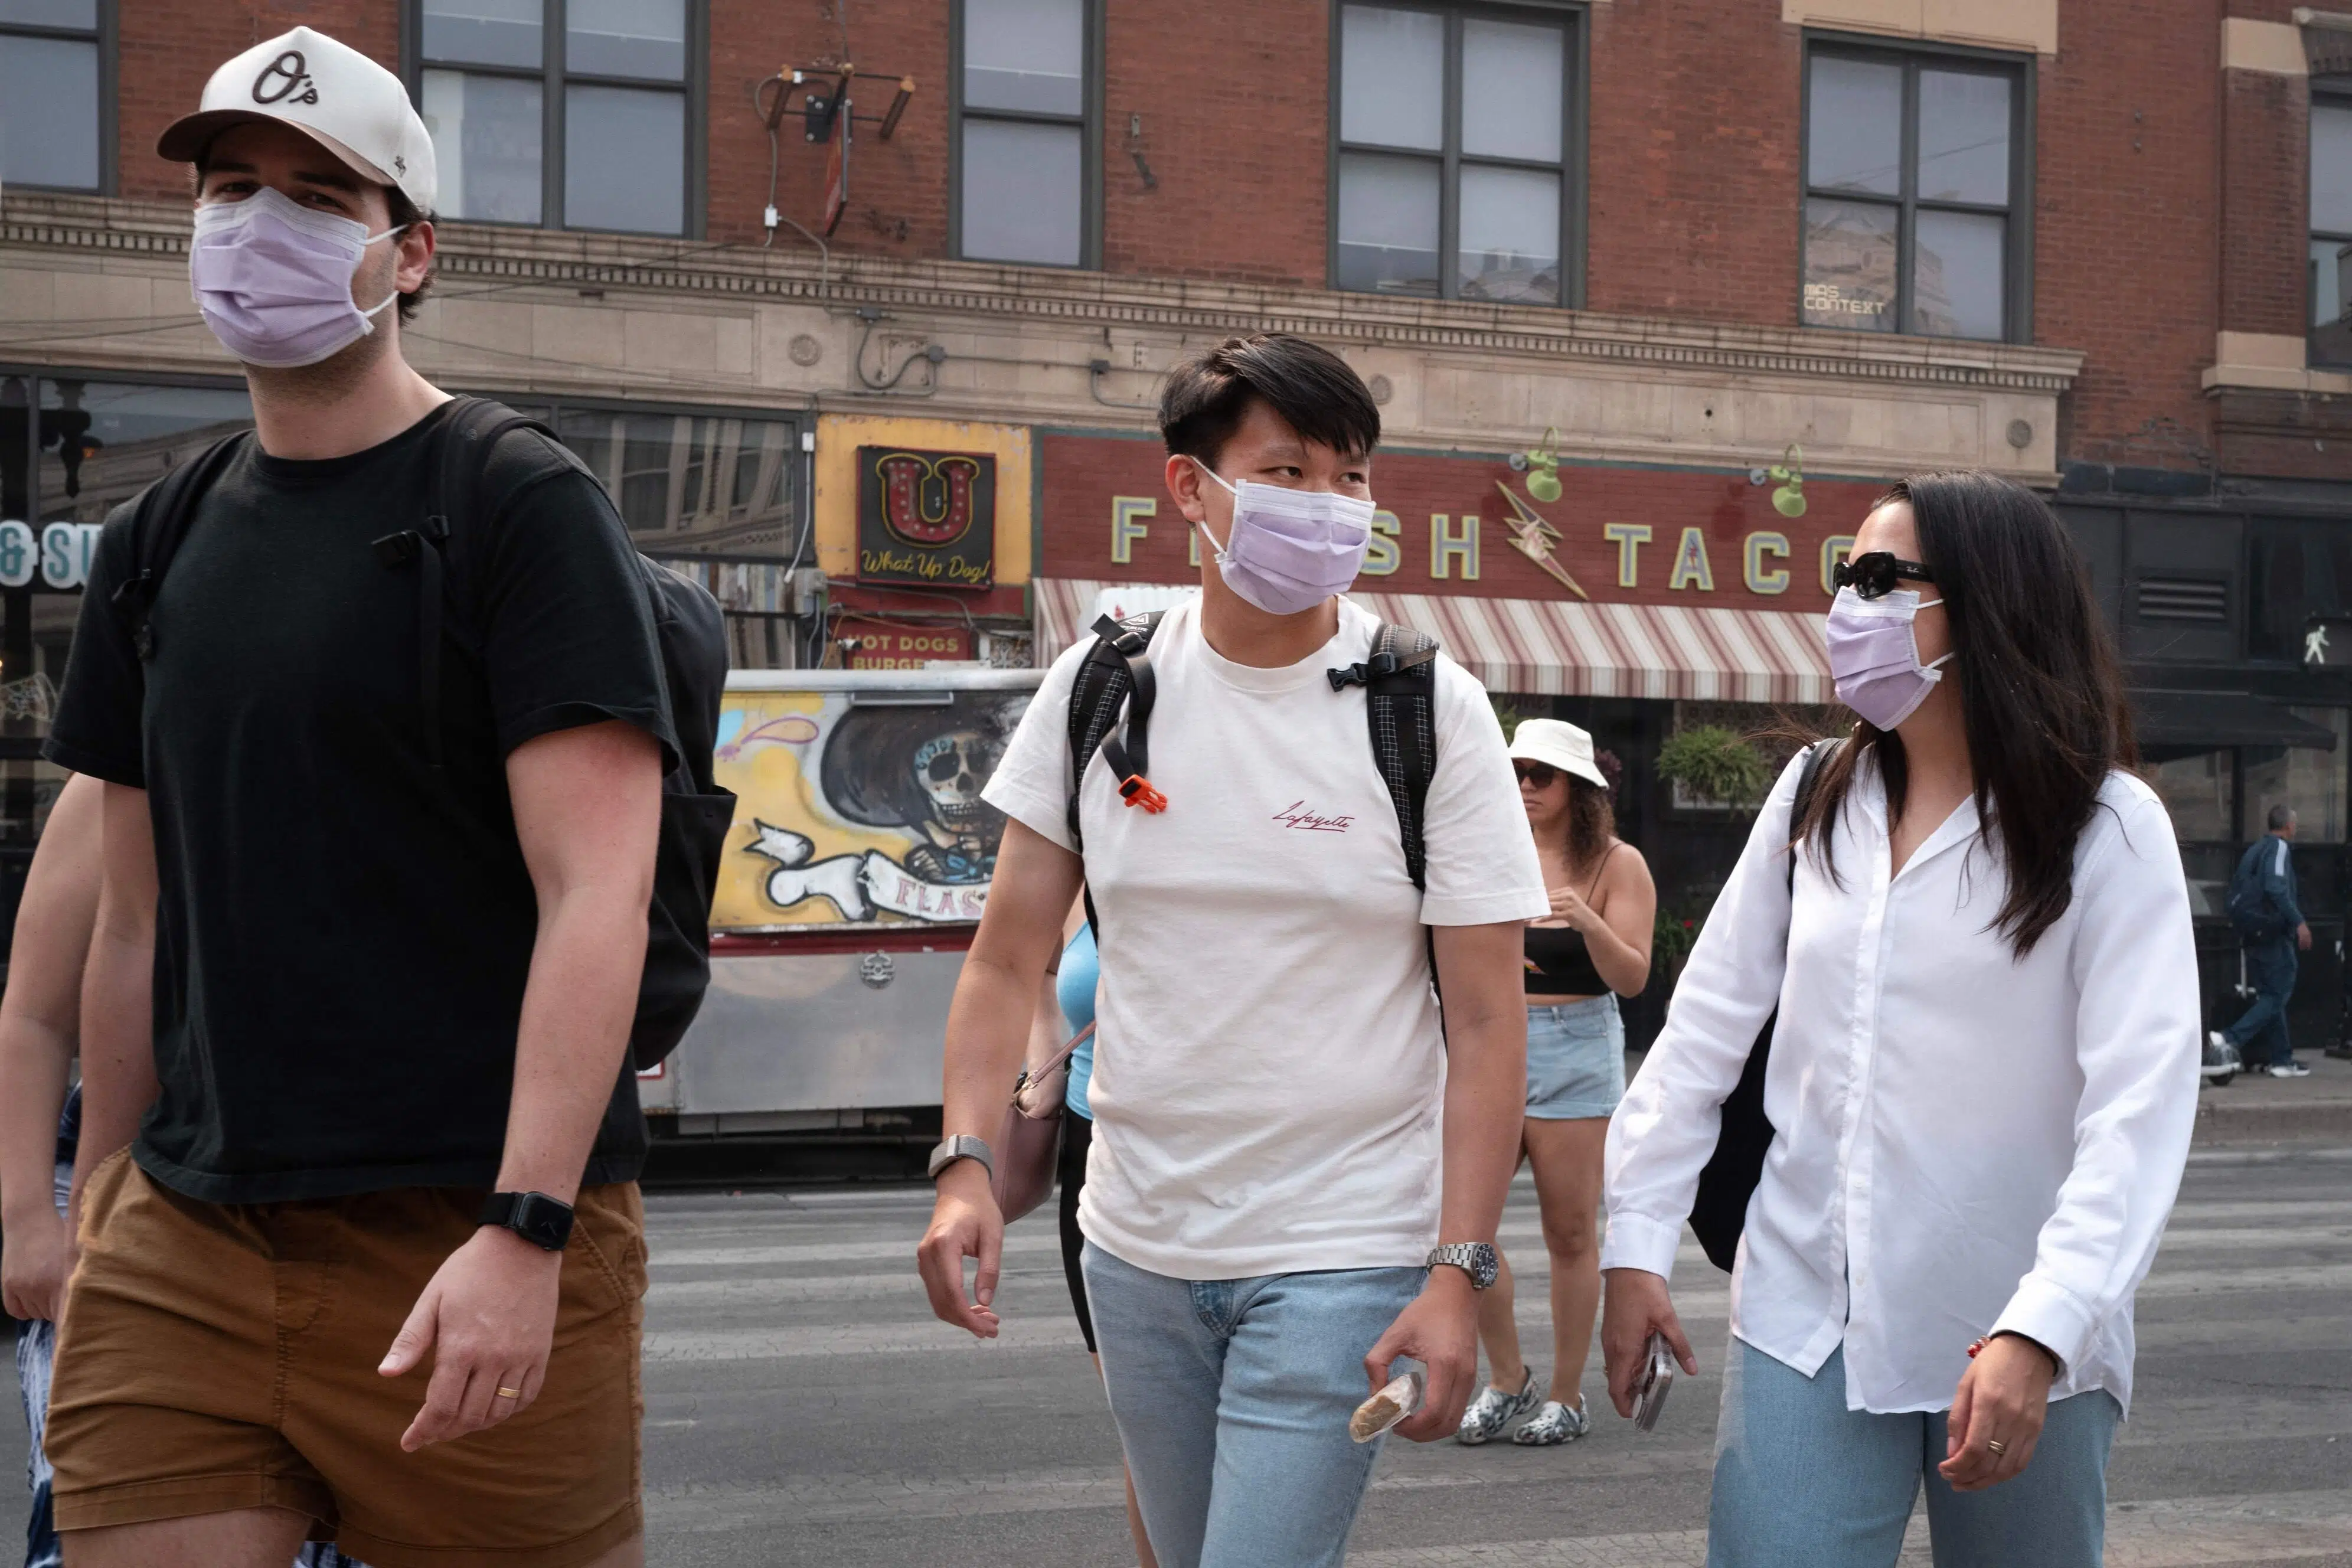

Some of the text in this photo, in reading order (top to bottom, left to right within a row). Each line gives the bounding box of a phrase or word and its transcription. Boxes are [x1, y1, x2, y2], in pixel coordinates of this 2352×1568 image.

[252, 50, 318, 104] O's
[1804, 296, 1884, 314] CONTEXT
[876, 453, 980, 548] U
[1111, 495, 1480, 580] FSH
[861, 549, 991, 584] What Up Dog!
[847, 634, 959, 652] OT DOGS
[853, 656, 925, 670] BURGE
[896, 877, 986, 916] FLAS
